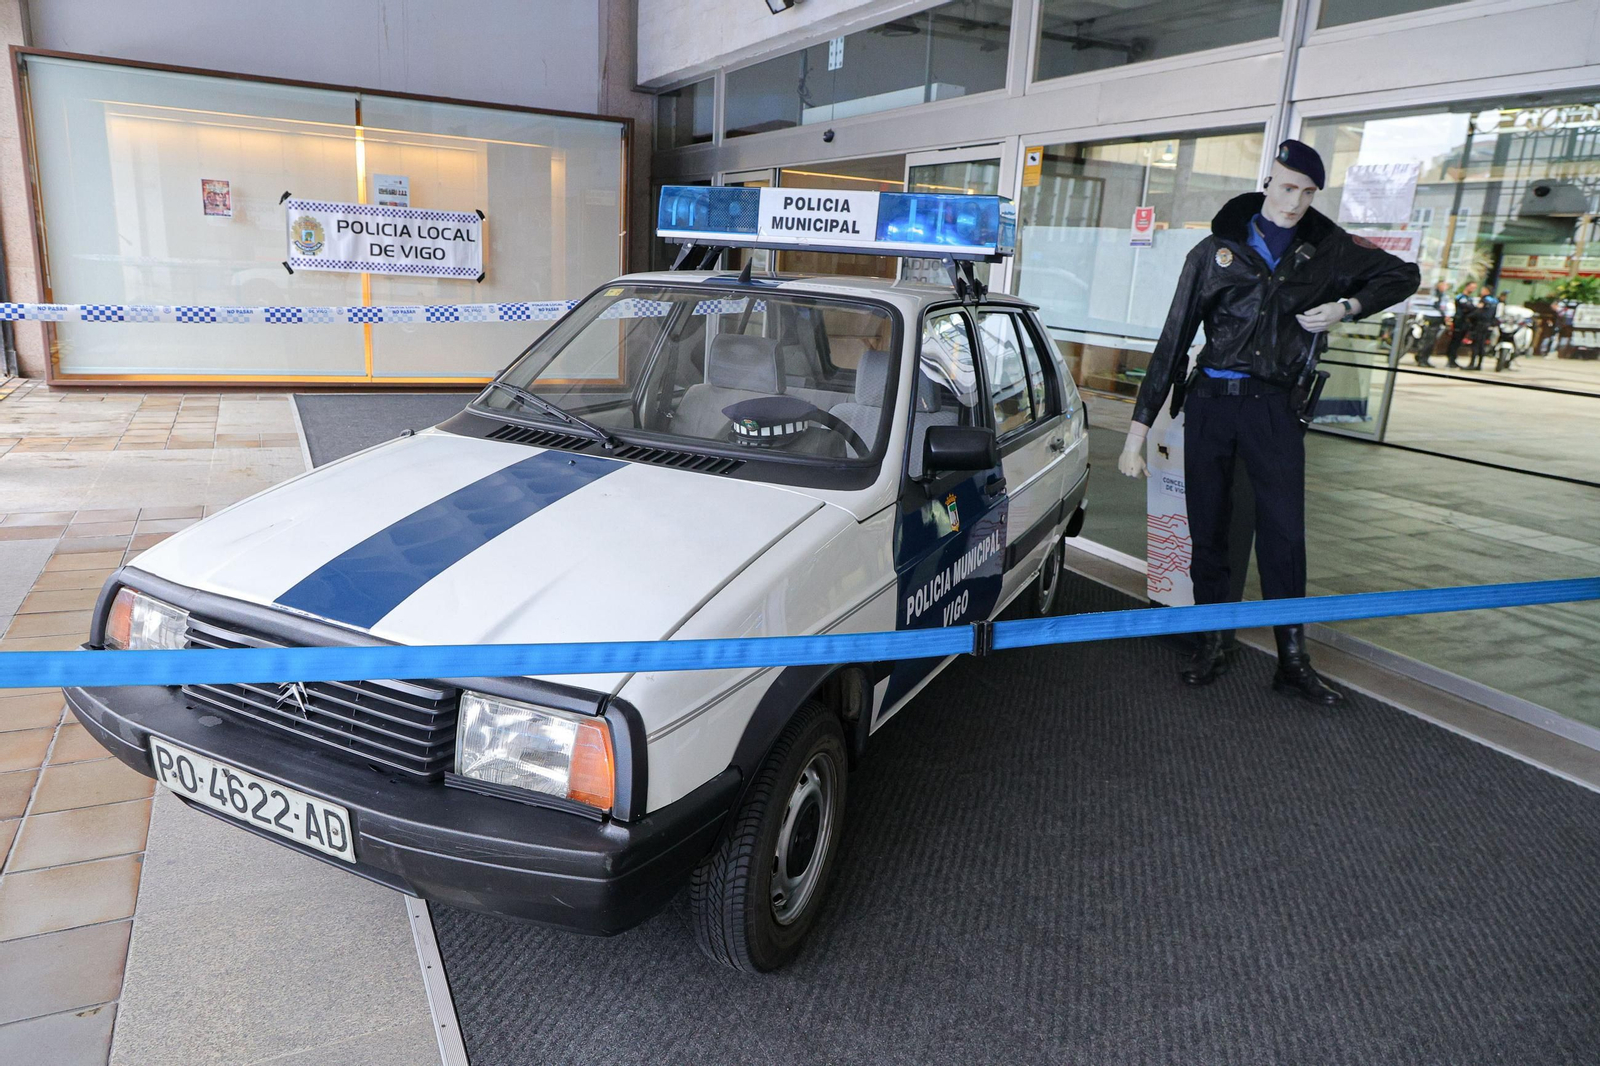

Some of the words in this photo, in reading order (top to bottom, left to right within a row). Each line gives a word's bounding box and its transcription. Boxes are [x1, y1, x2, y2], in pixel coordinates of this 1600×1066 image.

[783, 196, 851, 213] POLICIA
[336, 219, 412, 239] POLICIA
[417, 225, 476, 242] LOCAL
[771, 216, 860, 234] MUNICIPAL
[369, 243, 395, 257] DE
[400, 245, 446, 260] VIGO
[906, 567, 951, 625] POLICIA
[952, 529, 1000, 587] MUNICIPAL
[943, 589, 969, 627] VIGO
